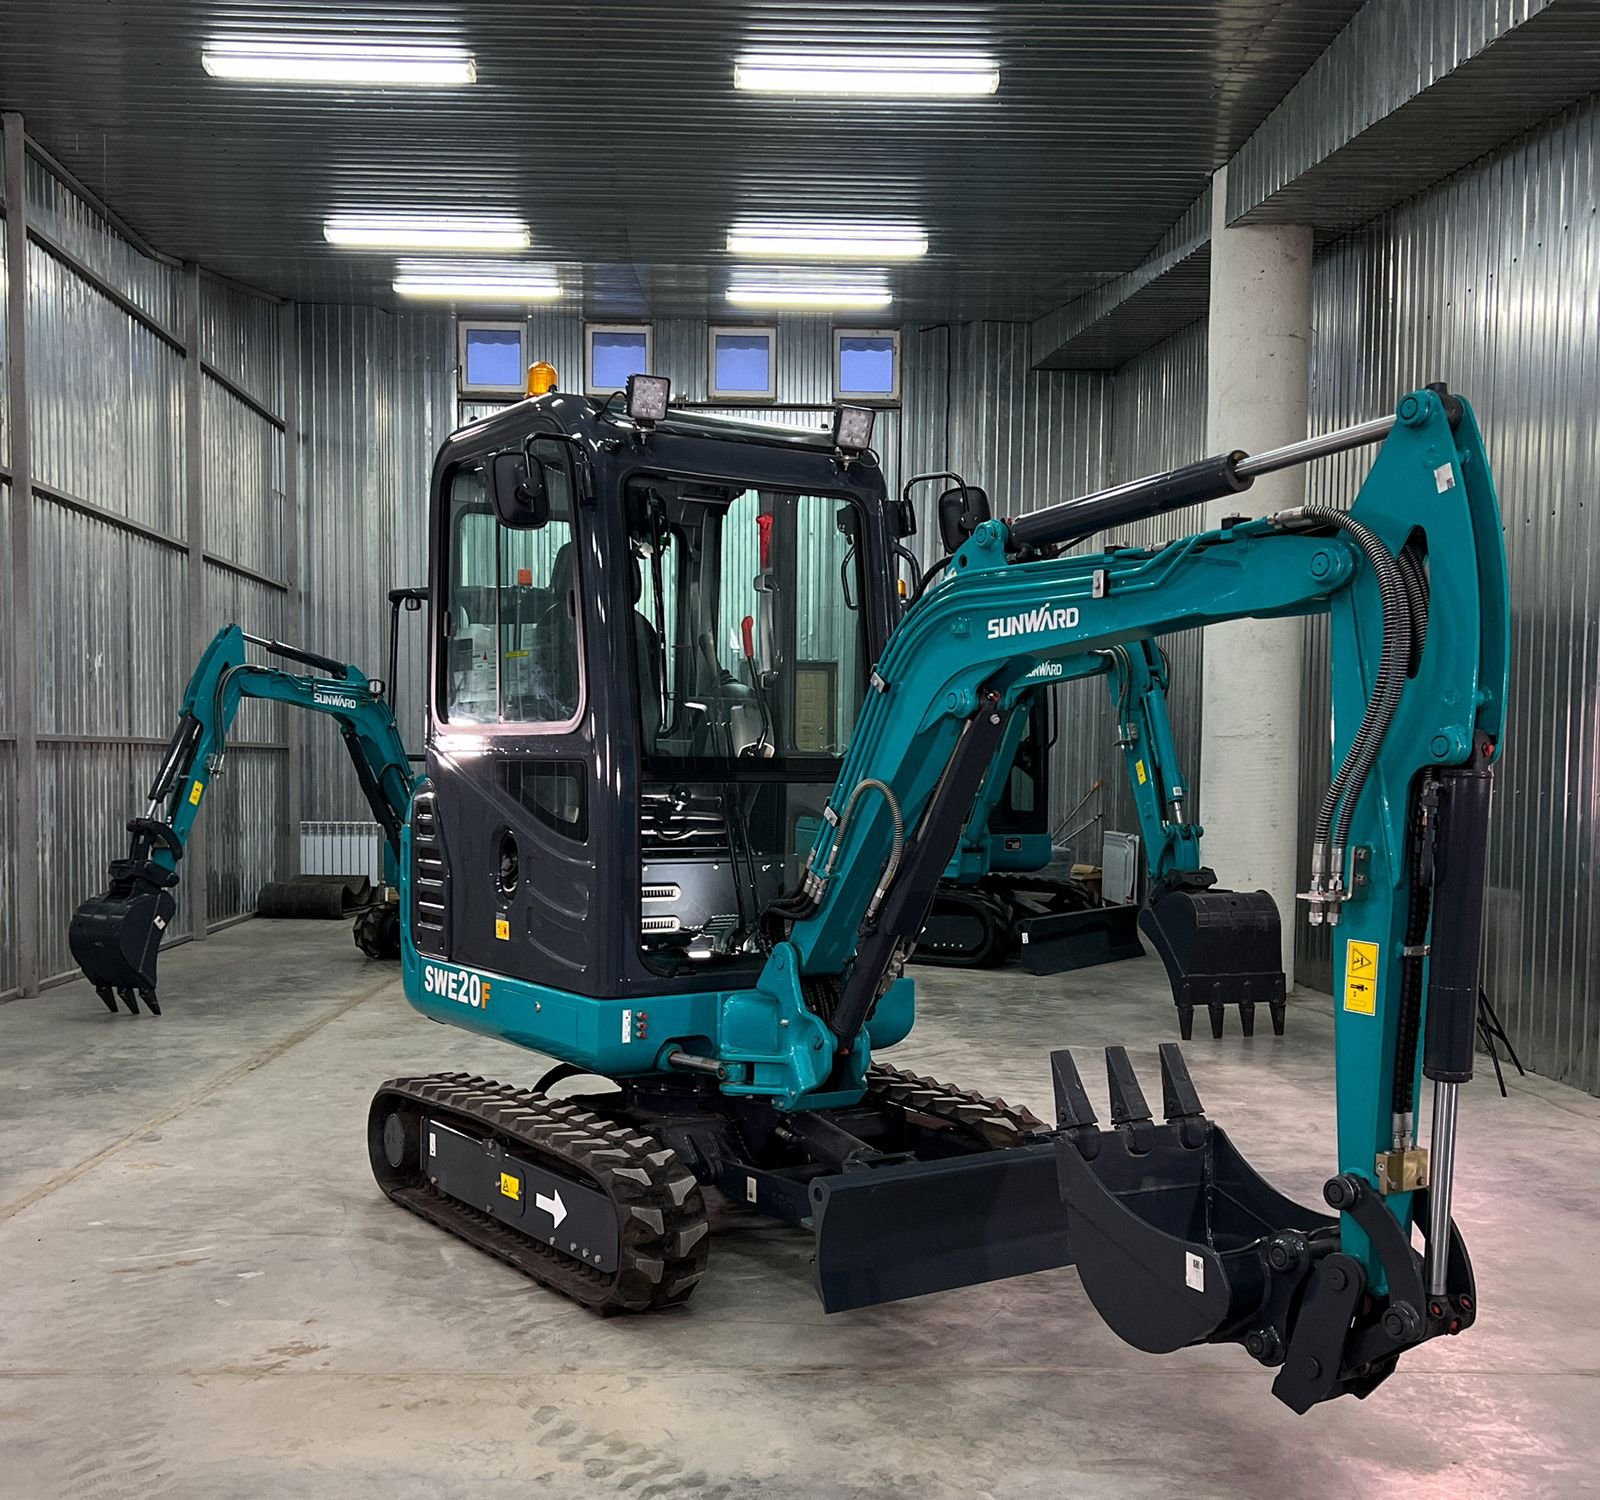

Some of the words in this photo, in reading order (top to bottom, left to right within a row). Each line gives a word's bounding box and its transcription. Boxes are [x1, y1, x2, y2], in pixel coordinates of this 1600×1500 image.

[987, 603, 1079, 639] SUNWARD
[313, 693, 356, 709] SUNWARD
[424, 965, 491, 1009] SWE20F
